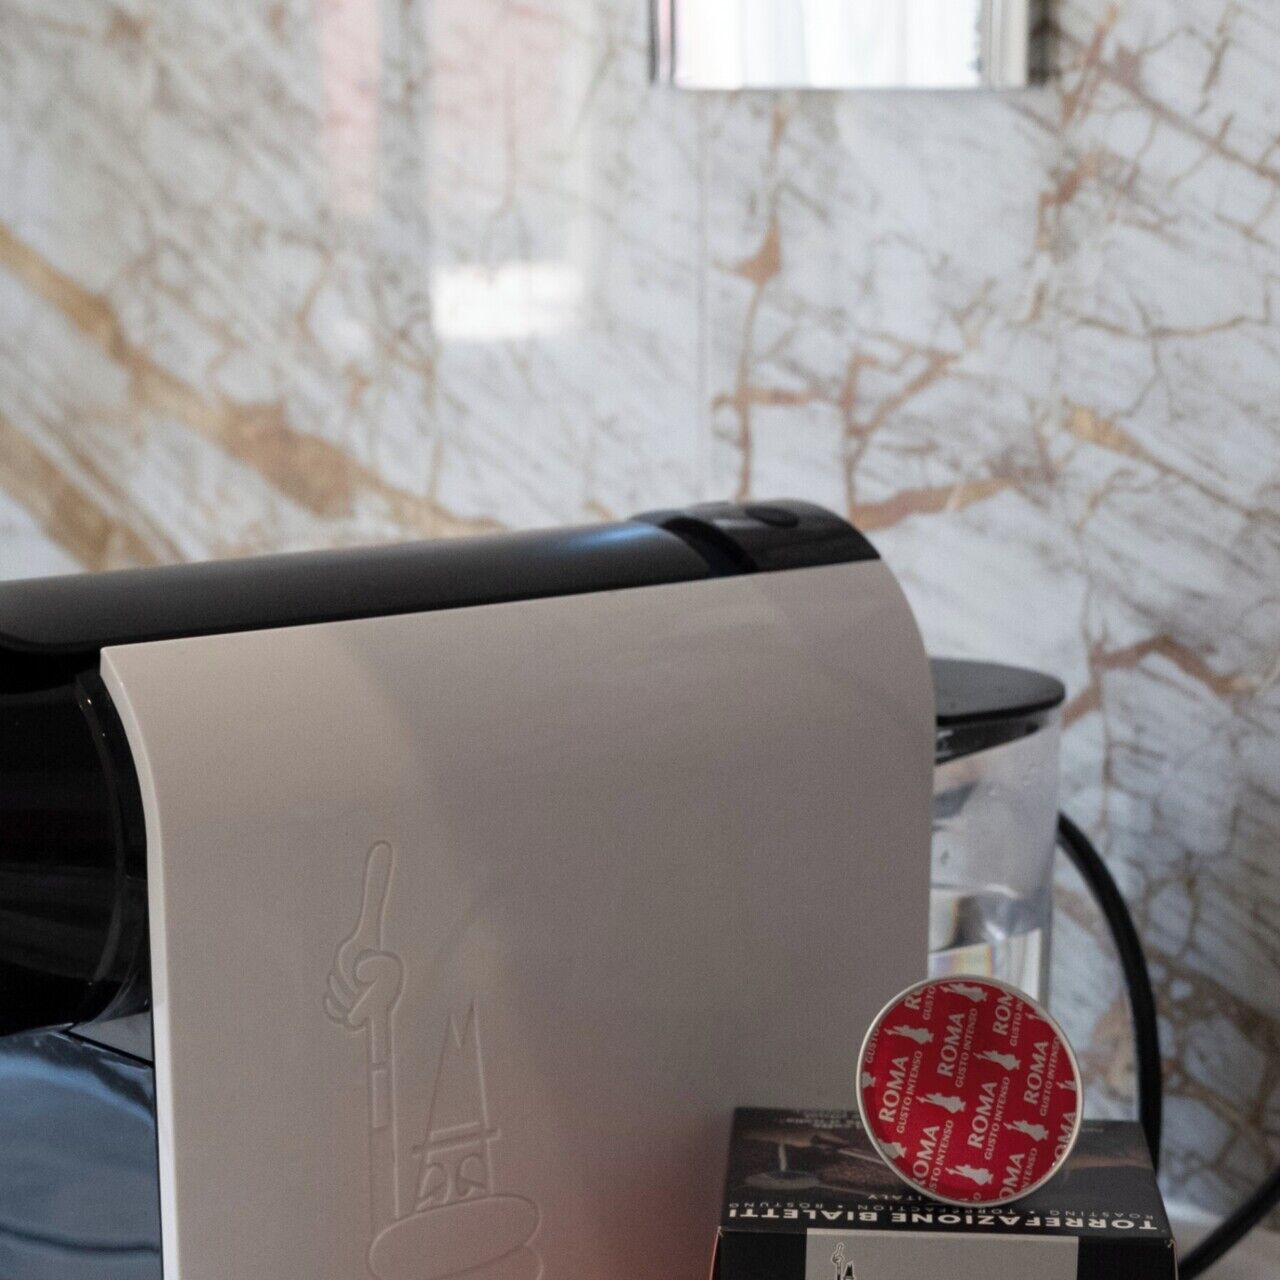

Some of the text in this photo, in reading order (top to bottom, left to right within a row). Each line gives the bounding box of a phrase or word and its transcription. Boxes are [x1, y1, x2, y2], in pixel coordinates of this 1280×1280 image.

[936, 1013, 966, 1077] ROMA
[955, 1007, 979, 1088] GUSTO INTENSO
[1024, 1041, 1050, 1104] ROMA
[878, 1056, 910, 1123] ROMA
[896, 1050, 923, 1134] GUSTO INTENSO
[967, 1081, 998, 1149] ROMA
[984, 1076, 1011, 1160] GUSTO INTENSO
[1040, 1080, 1053, 1117] GUSTO
[935, 1119, 955, 1167] INTENSO
[728, 1208, 1158, 1230] TORREFAZIONE BIALETTI
[1048, 1209, 1154, 1221] ROASTING
